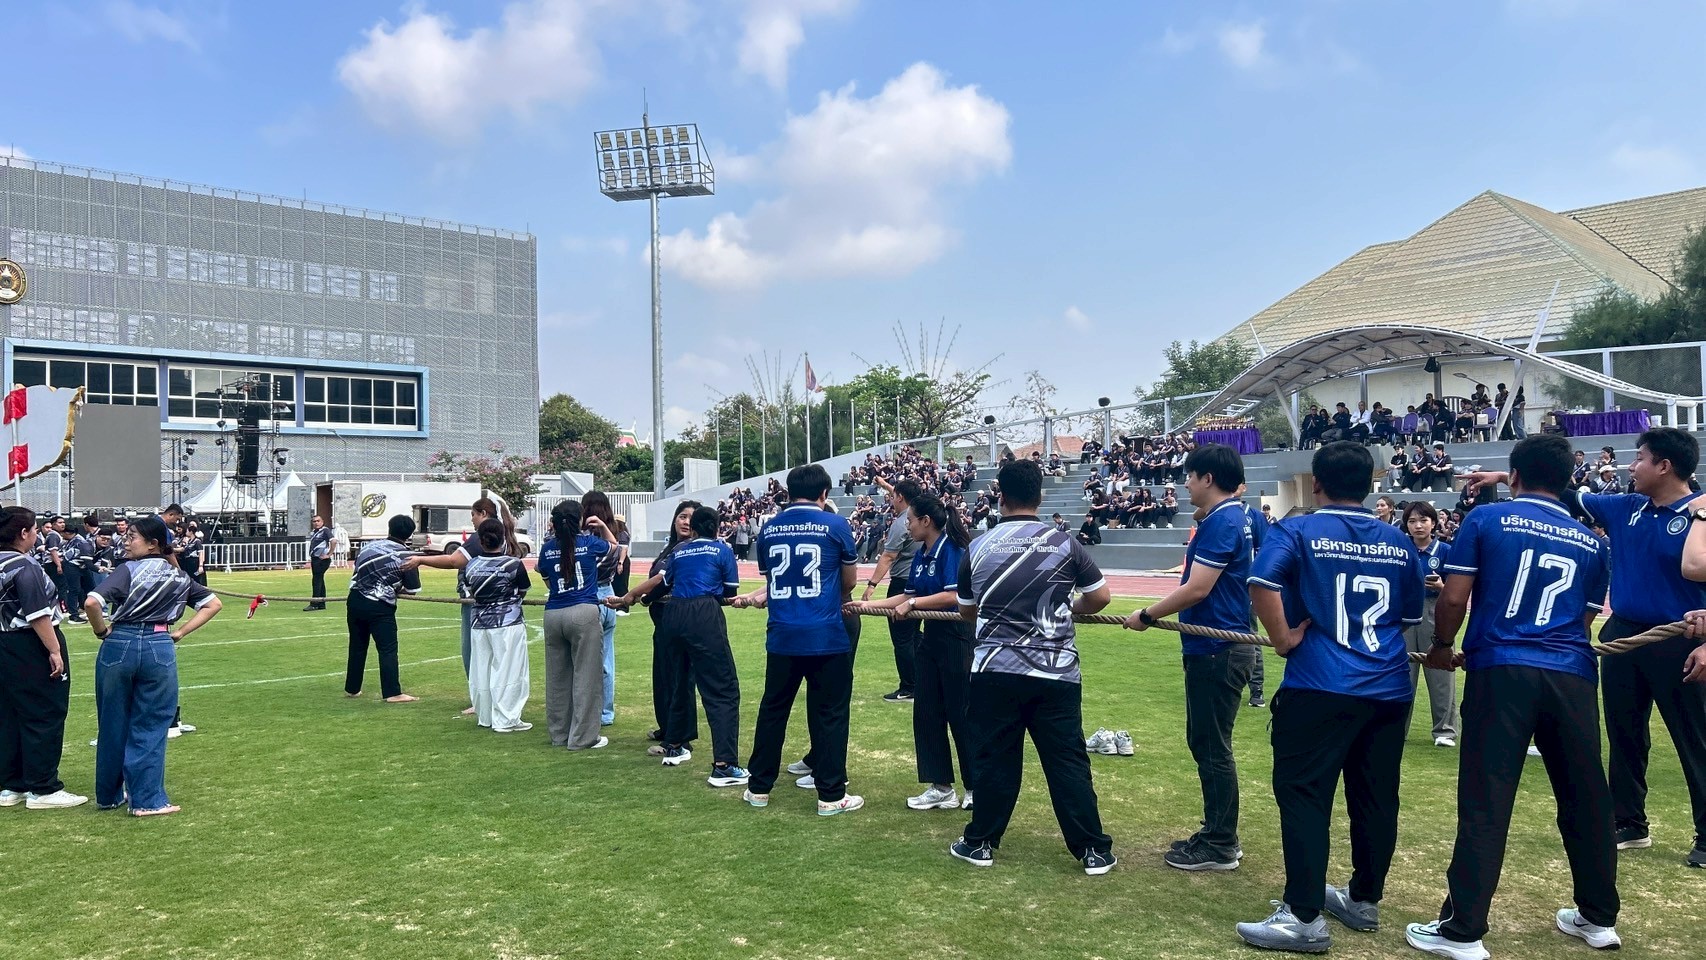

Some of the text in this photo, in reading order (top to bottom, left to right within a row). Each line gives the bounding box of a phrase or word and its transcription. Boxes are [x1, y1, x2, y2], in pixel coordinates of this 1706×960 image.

[763, 521, 830, 535] บริหารการศึกษา
[1311, 537, 1409, 559] บริหารการศึกษา
[1500, 514, 1600, 549] บริหารการศึกษา
[768, 543, 821, 600] 23
[1504, 548, 1578, 627] 17
[1335, 572, 1391, 653] 17
